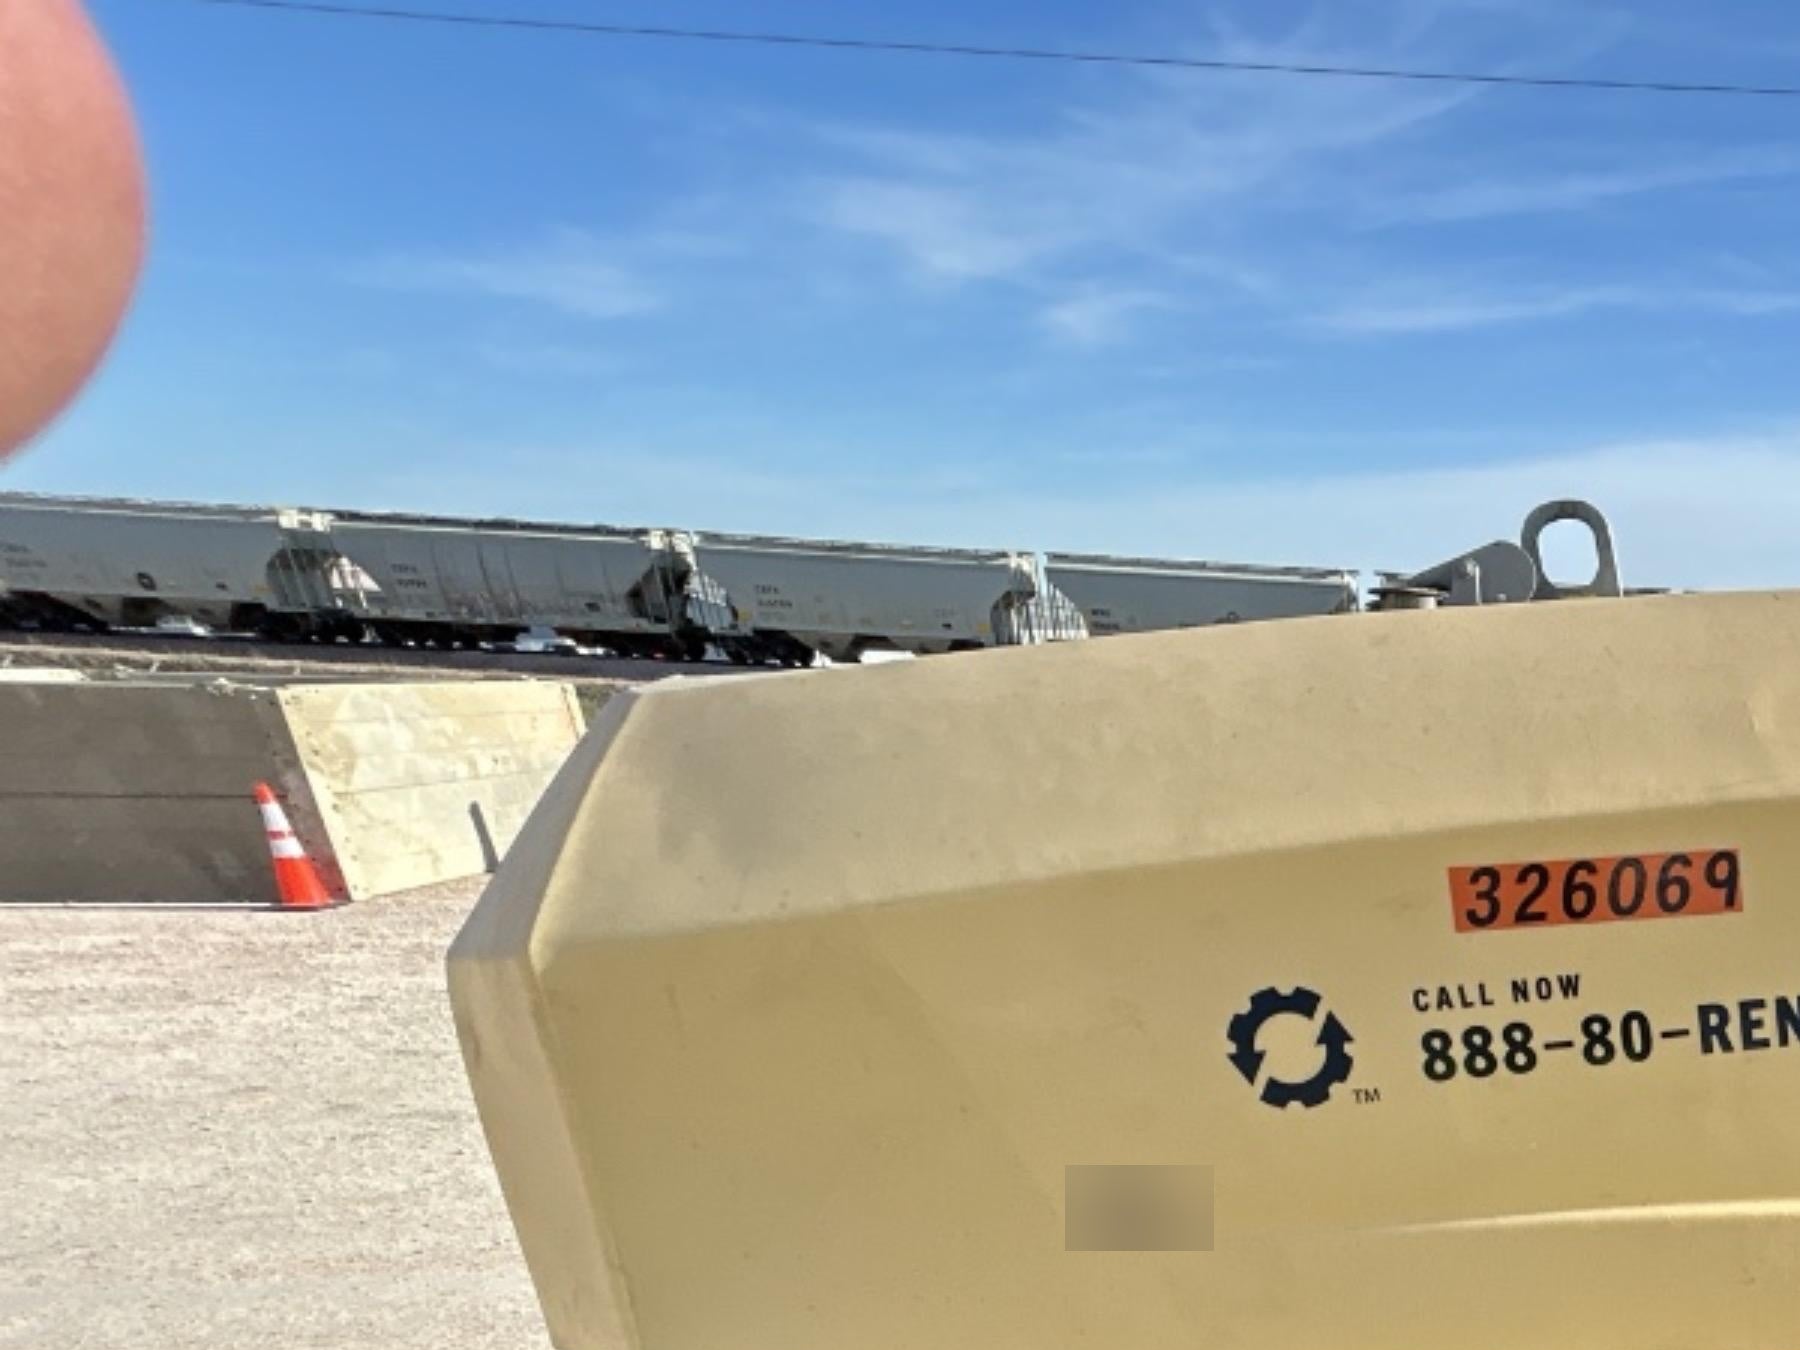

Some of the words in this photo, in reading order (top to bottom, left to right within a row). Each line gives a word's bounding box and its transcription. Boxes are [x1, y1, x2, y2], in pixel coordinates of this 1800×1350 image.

[1466, 850, 1741, 928] 326069
[1412, 985, 1496, 1013] CALL
[1511, 973, 1583, 1005] NOW
